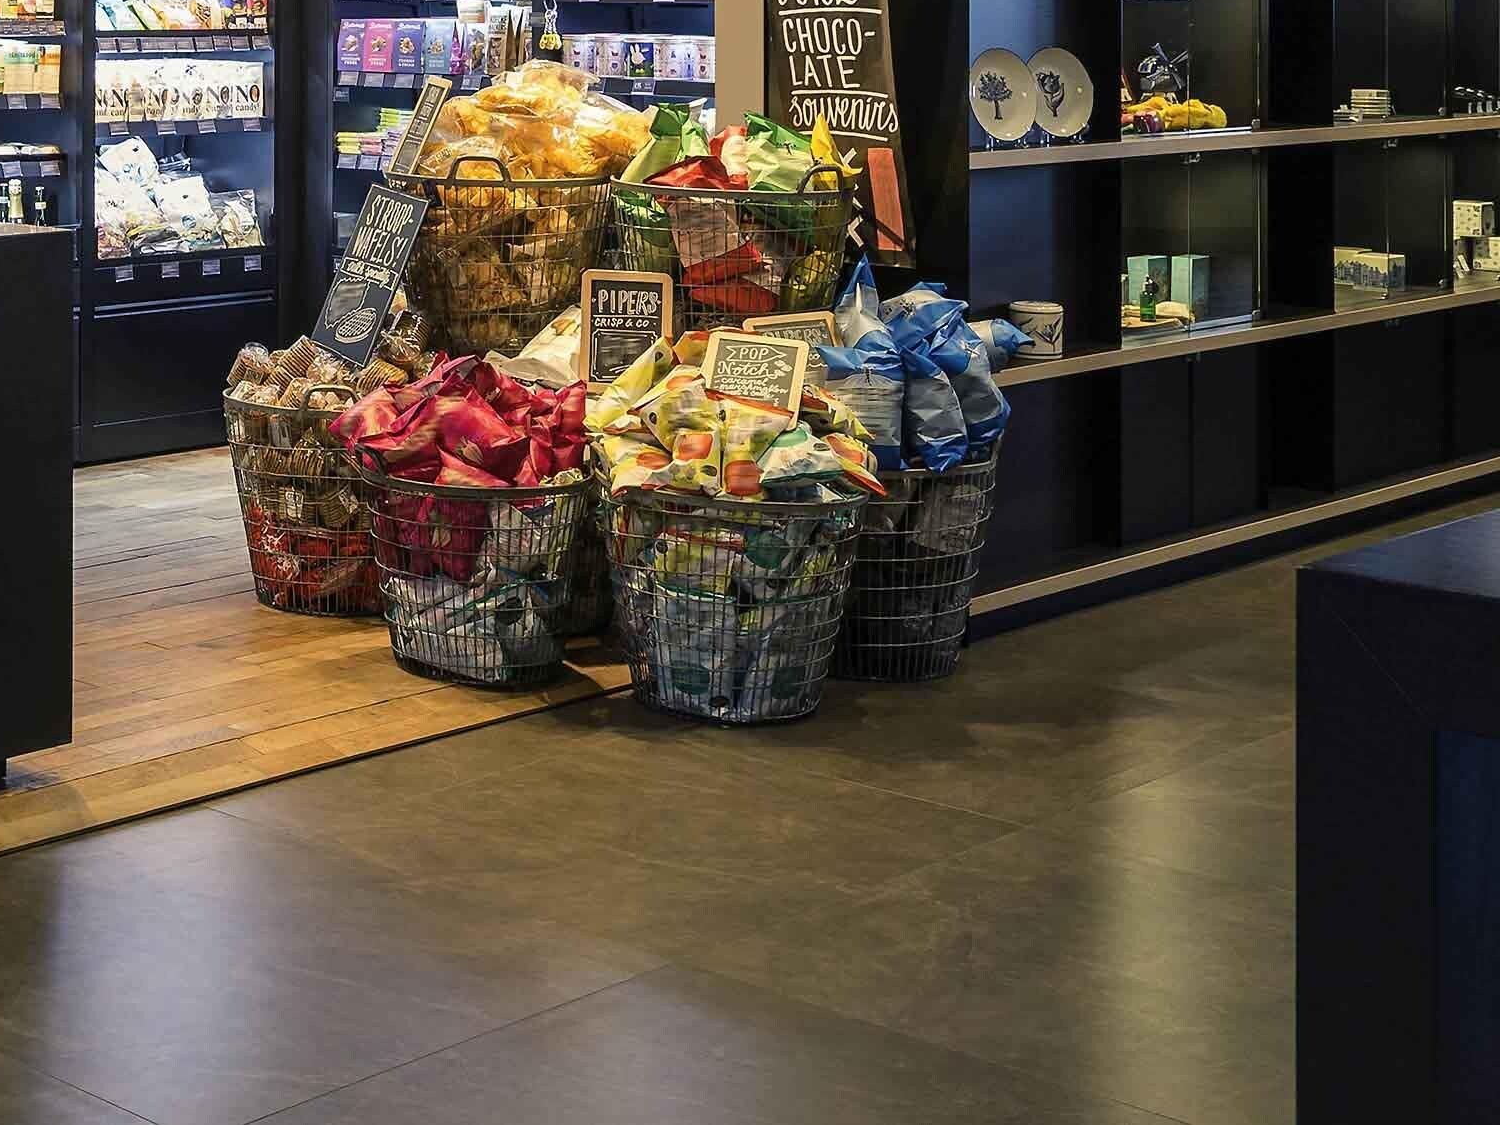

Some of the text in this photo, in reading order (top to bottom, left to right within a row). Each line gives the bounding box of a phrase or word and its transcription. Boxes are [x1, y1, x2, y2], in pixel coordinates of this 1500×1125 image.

[782, 17, 876, 57] CHOCO-
[788, 54, 861, 89] LATE
[236, 84, 260, 104] NO
[788, 95, 900, 135] souvenirs
[352, 226, 409, 268] WAFELS!
[597, 288, 659, 316] PIPERS
[594, 318, 650, 328] CRISP & CO
[739, 347, 770, 360] POP
[717, 360, 770, 377] Notch
